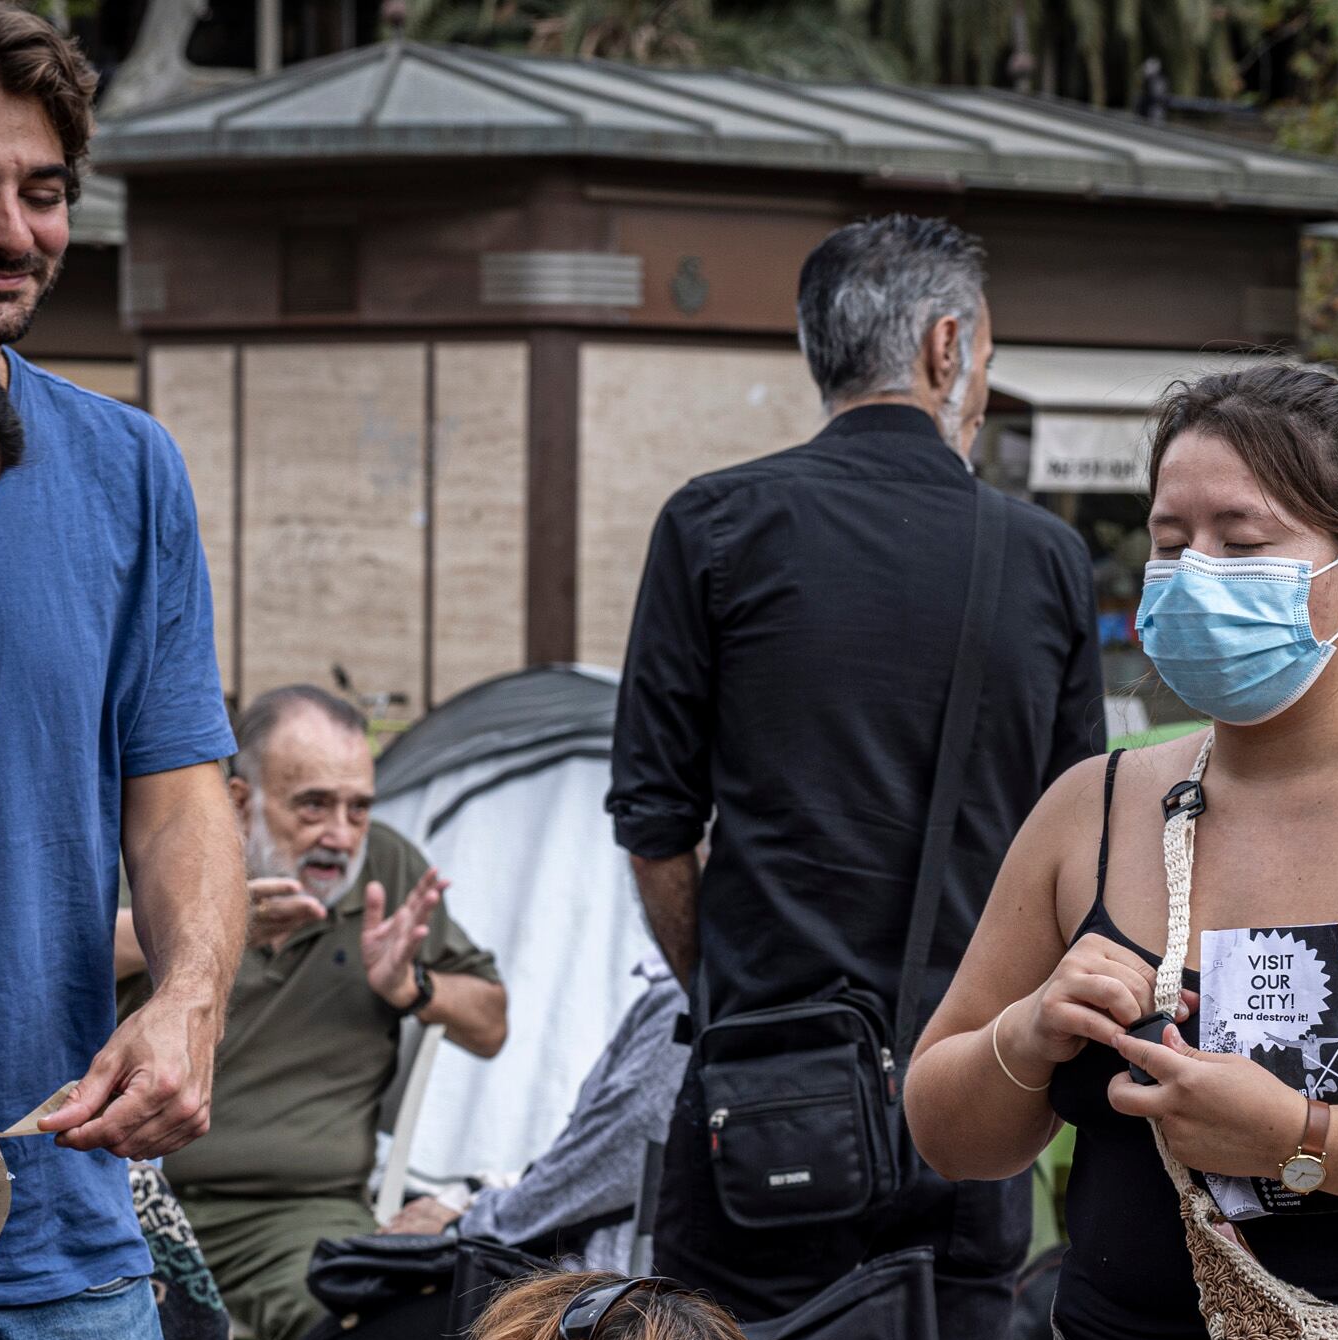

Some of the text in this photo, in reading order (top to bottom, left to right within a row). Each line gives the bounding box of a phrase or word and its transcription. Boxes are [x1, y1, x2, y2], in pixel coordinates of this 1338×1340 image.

[1248, 954, 1294, 970] VISIT
[1251, 974, 1291, 990] OUR
[1247, 993, 1295, 1010] CITY!
[1233, 1012, 1309, 1024] and destroy it!
